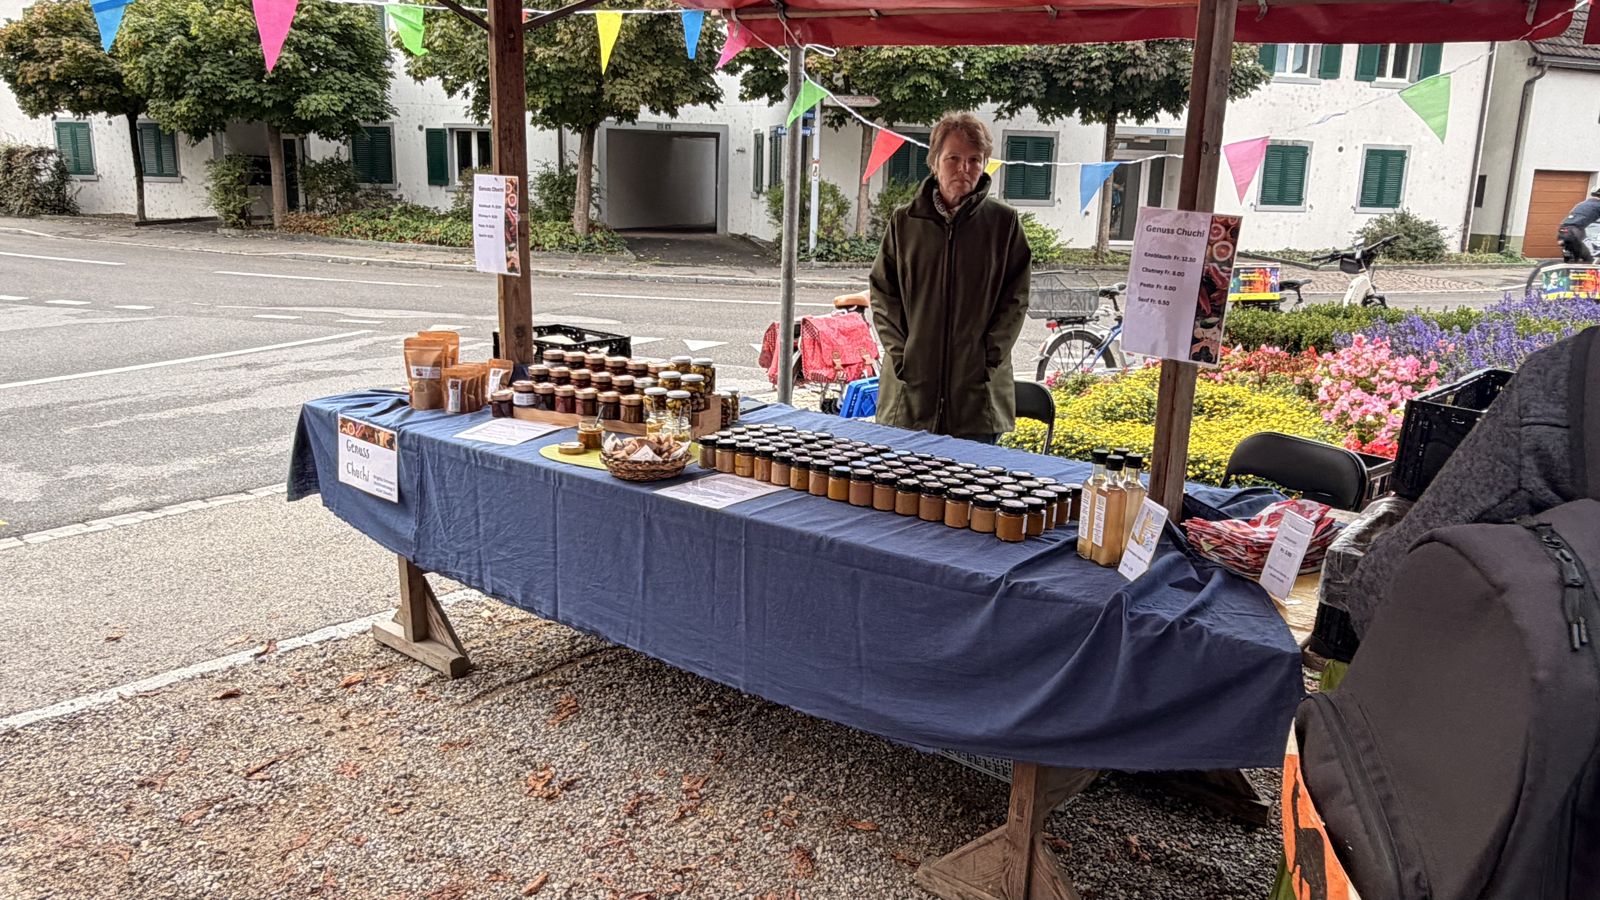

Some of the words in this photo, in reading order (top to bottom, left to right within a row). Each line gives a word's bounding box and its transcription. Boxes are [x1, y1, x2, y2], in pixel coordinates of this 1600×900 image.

[1146, 224, 1175, 234] Genuss
[1176, 228, 1205, 237] Chuchi
[346, 439, 370, 459] Genuss
[346, 461, 370, 482] Chuchi
